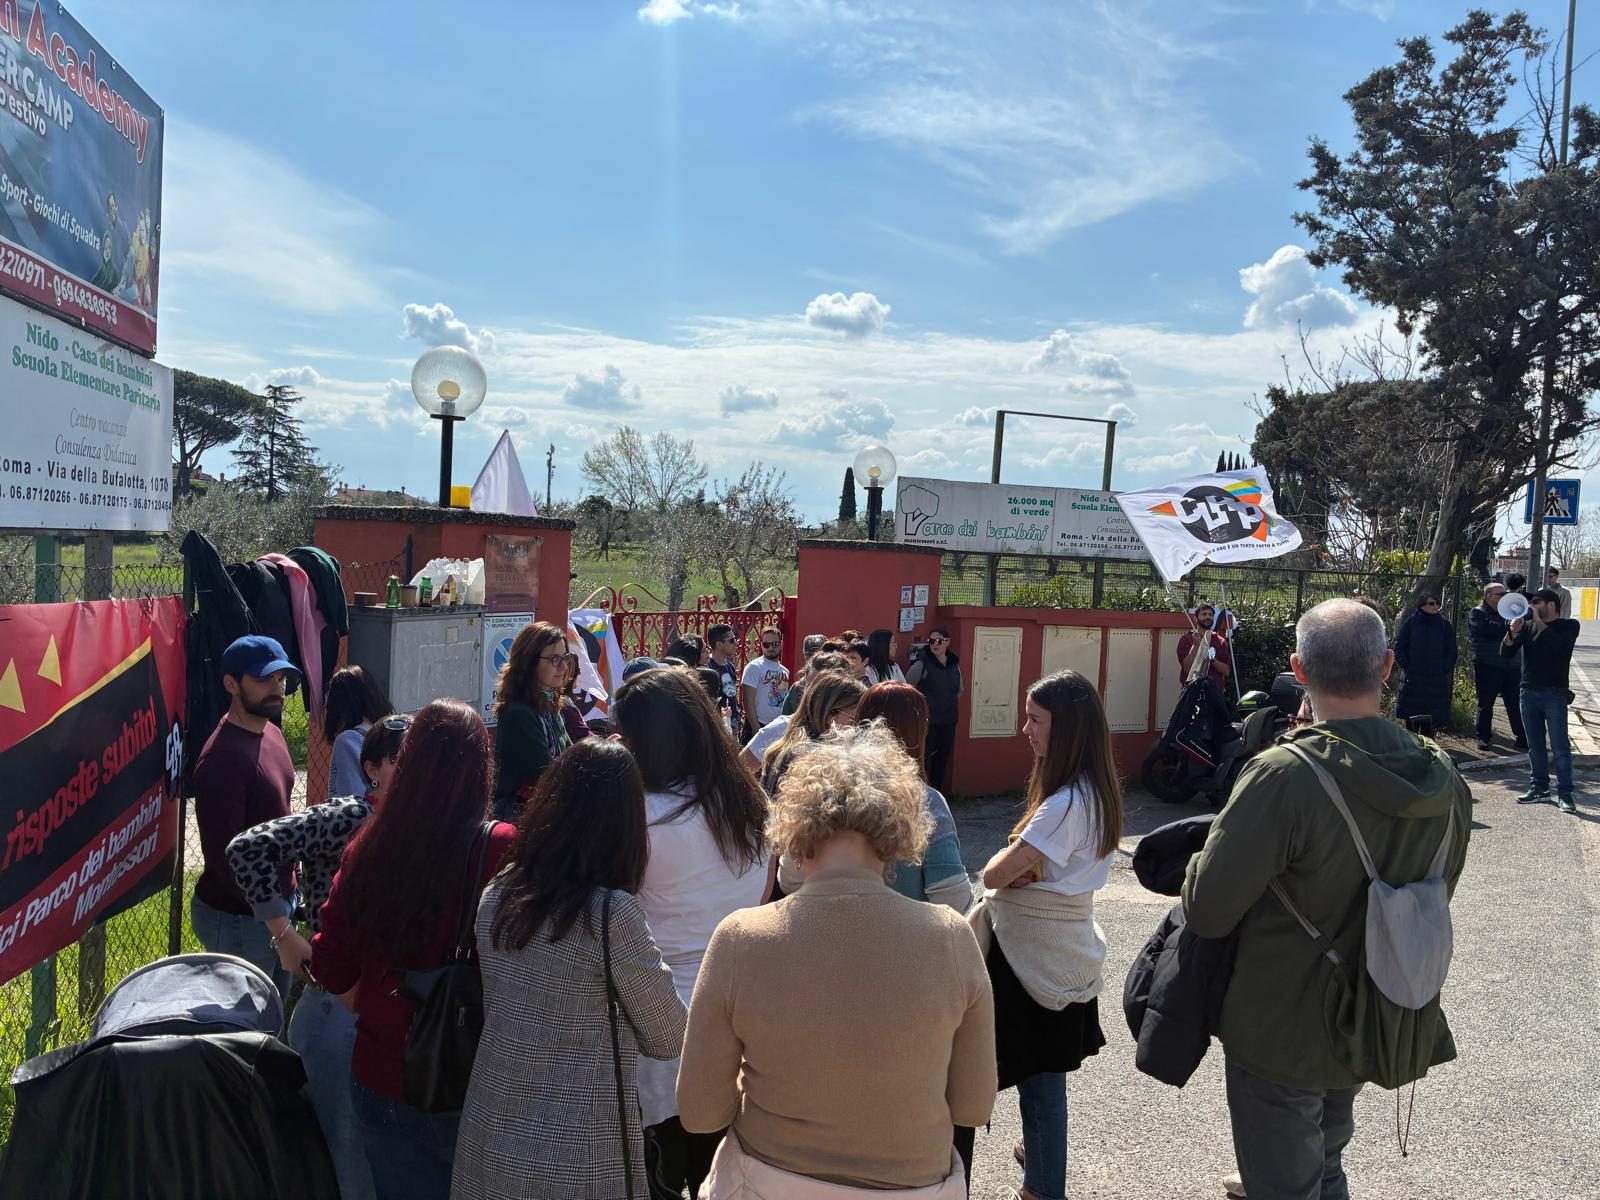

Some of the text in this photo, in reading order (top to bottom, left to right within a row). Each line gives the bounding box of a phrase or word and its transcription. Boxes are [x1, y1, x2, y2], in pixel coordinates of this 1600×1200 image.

[0, 45, 74, 130] ER CAMP
[27, 0, 149, 164] Academy
[9, 95, 46, 136] estivo
[0, 174, 29, 206] Sport
[33, 194, 60, 225] Giochi
[61, 211, 70, 231] di
[70, 217, 101, 251] Squadra
[53, 275, 118, 325] 0694838953
[26, 322, 59, 351] Nido
[72, 341, 98, 366] Casa
[100, 351, 114, 373] dei
[116, 358, 153, 387] bambini
[12, 345, 161, 412] Scuola Elementare Paritaria
[70, 407, 96, 431] Centro
[55, 434, 137, 466] Consulenza Didattica
[0, 456, 31, 475] oma
[47, 460, 67, 479] Via
[70, 465, 97, 484] della
[102, 469, 147, 492] Bufalotta,
[10, 485, 71, 504] 06.87120266
[79, 493, 128, 508] 06.87120175
[1007, 496, 1054, 509] 26.000 mq
[1010, 508, 1050, 517] di verde
[1071, 502, 1123, 513] Scuola Elem
[1080, 494, 1100, 503] Nido
[958, 519, 978, 537] dei
[986, 520, 1050, 541] bambini
[1061, 532, 1084, 541] Roma
[1091, 534, 1105, 542] Via
[1107, 535, 1128, 543] della
[980, 709, 1007, 724] GAS
[2, 696, 158, 870] risposte subito!
[20, 871, 77, 937] Parco
[79, 839, 106, 887] dei
[107, 786, 163, 861] bambini
[72, 824, 159, 927] Montessori
